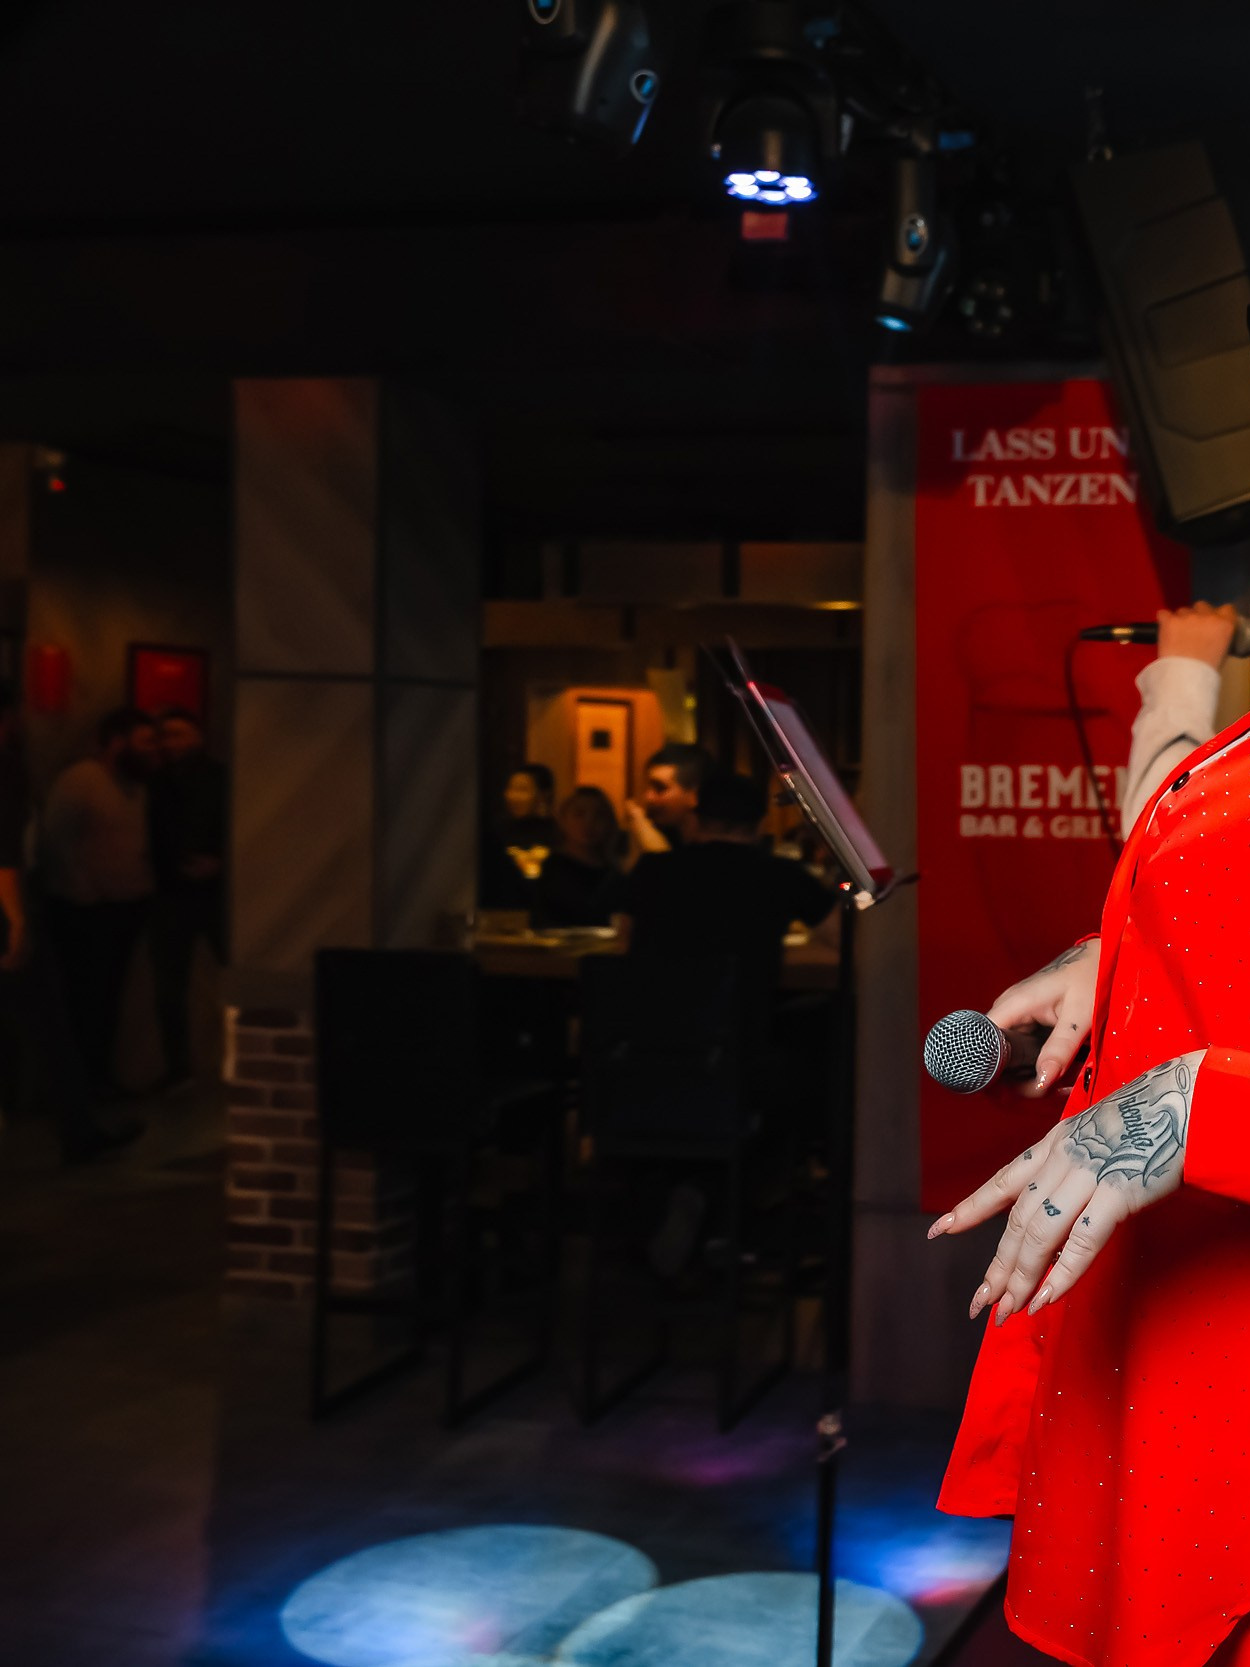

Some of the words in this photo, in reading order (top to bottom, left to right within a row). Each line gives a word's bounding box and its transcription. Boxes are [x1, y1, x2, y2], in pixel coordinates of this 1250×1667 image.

[952, 427, 1056, 461] LASS
[1068, 426, 1130, 460] UN
[966, 472, 1138, 507] TANZEN
[960, 813, 1017, 838] BAR
[1022, 815, 1045, 838] &
